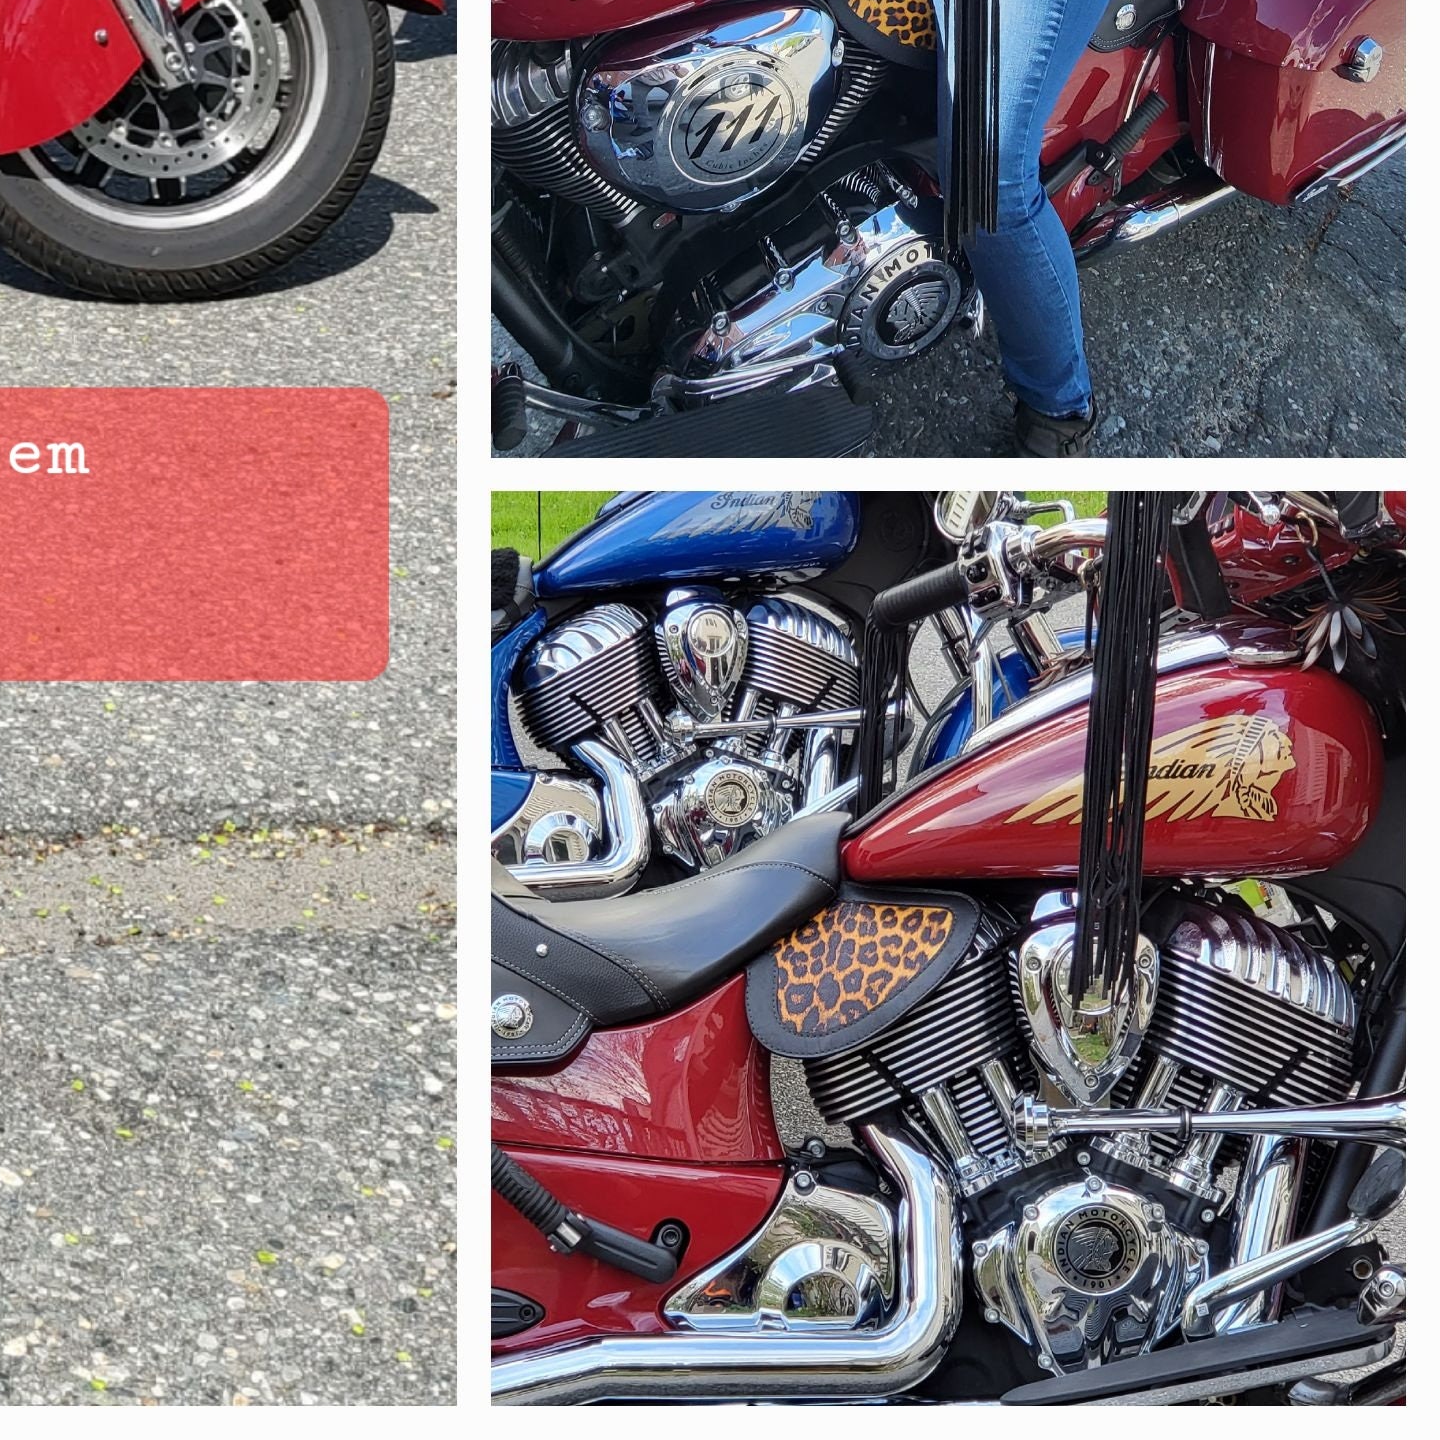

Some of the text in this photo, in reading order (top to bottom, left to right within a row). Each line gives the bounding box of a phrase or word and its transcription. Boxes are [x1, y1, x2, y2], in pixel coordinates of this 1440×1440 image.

[689, 94, 781, 159] 111
[706, 160, 733, 169] Cubic
[711, 491, 775, 510] Indian
[1147, 759, 1217, 780] ndian
[719, 773, 756, 811] MOTORCYCLE
[1057, 1209, 1137, 1274] INDIAN MOTORCYCLE
[1082, 1279, 1112, 1288] 1901
